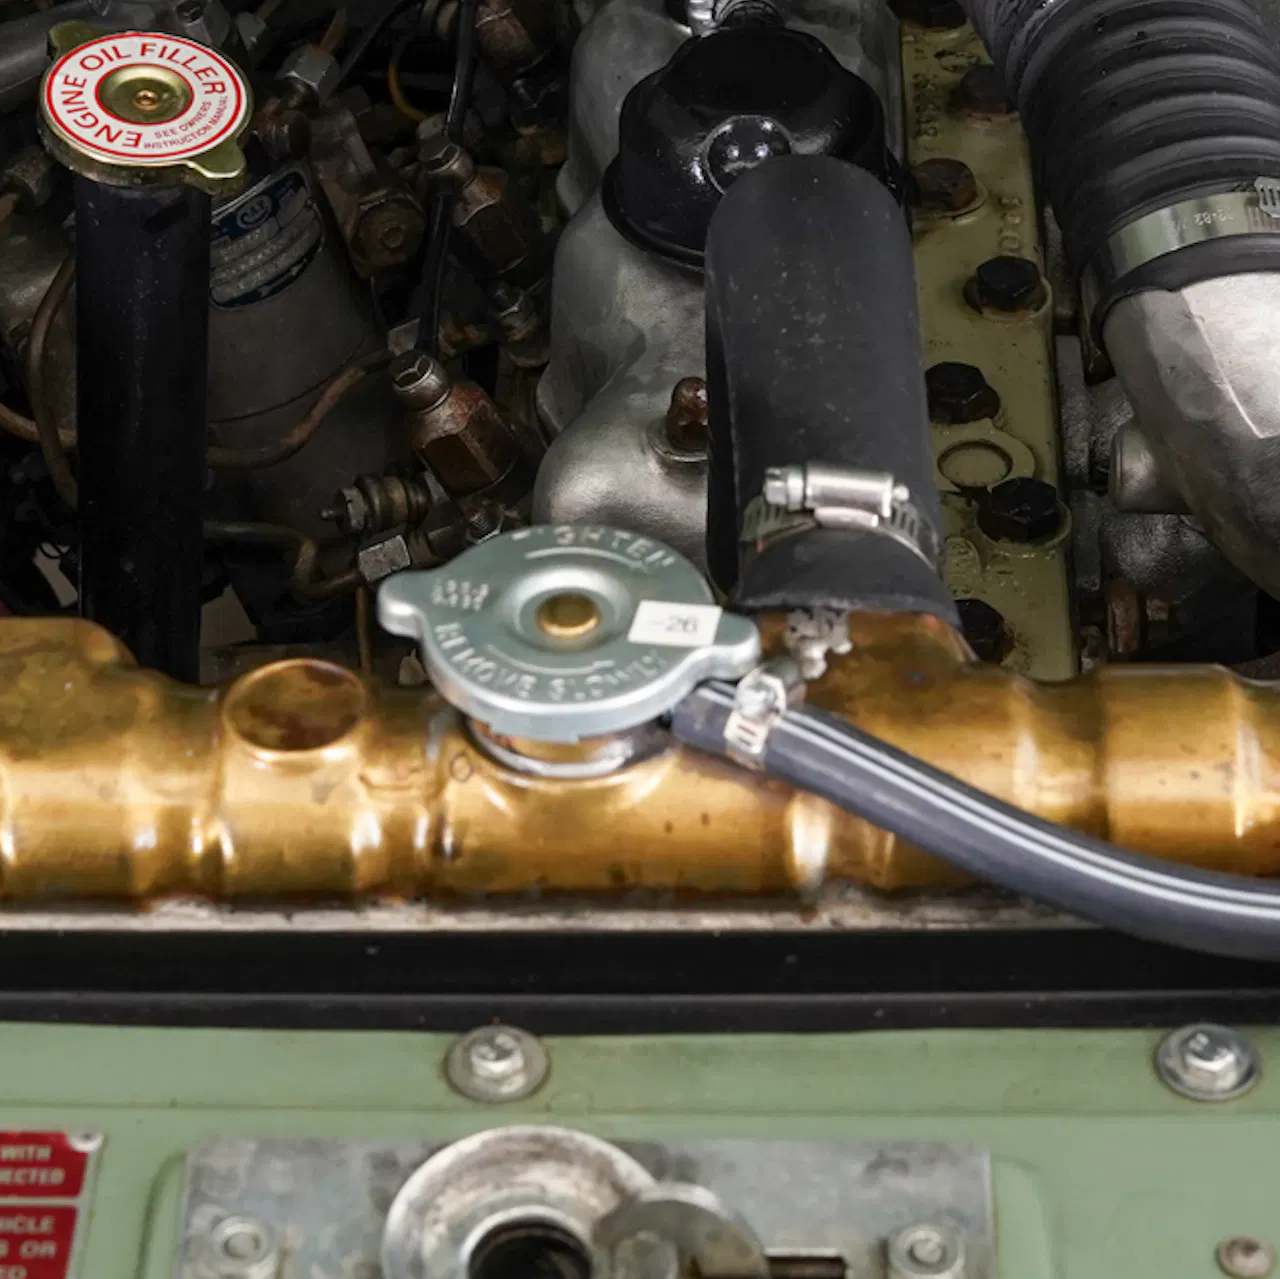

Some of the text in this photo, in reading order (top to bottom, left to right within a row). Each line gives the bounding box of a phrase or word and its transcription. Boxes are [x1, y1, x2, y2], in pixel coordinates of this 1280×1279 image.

[61, 42, 226, 149] ENGINE OIL FILLER
[143, 124, 212, 149] INSTRUCTION
[154, 128, 178, 139] SEE
[19, 1240, 58, 1259] OR
